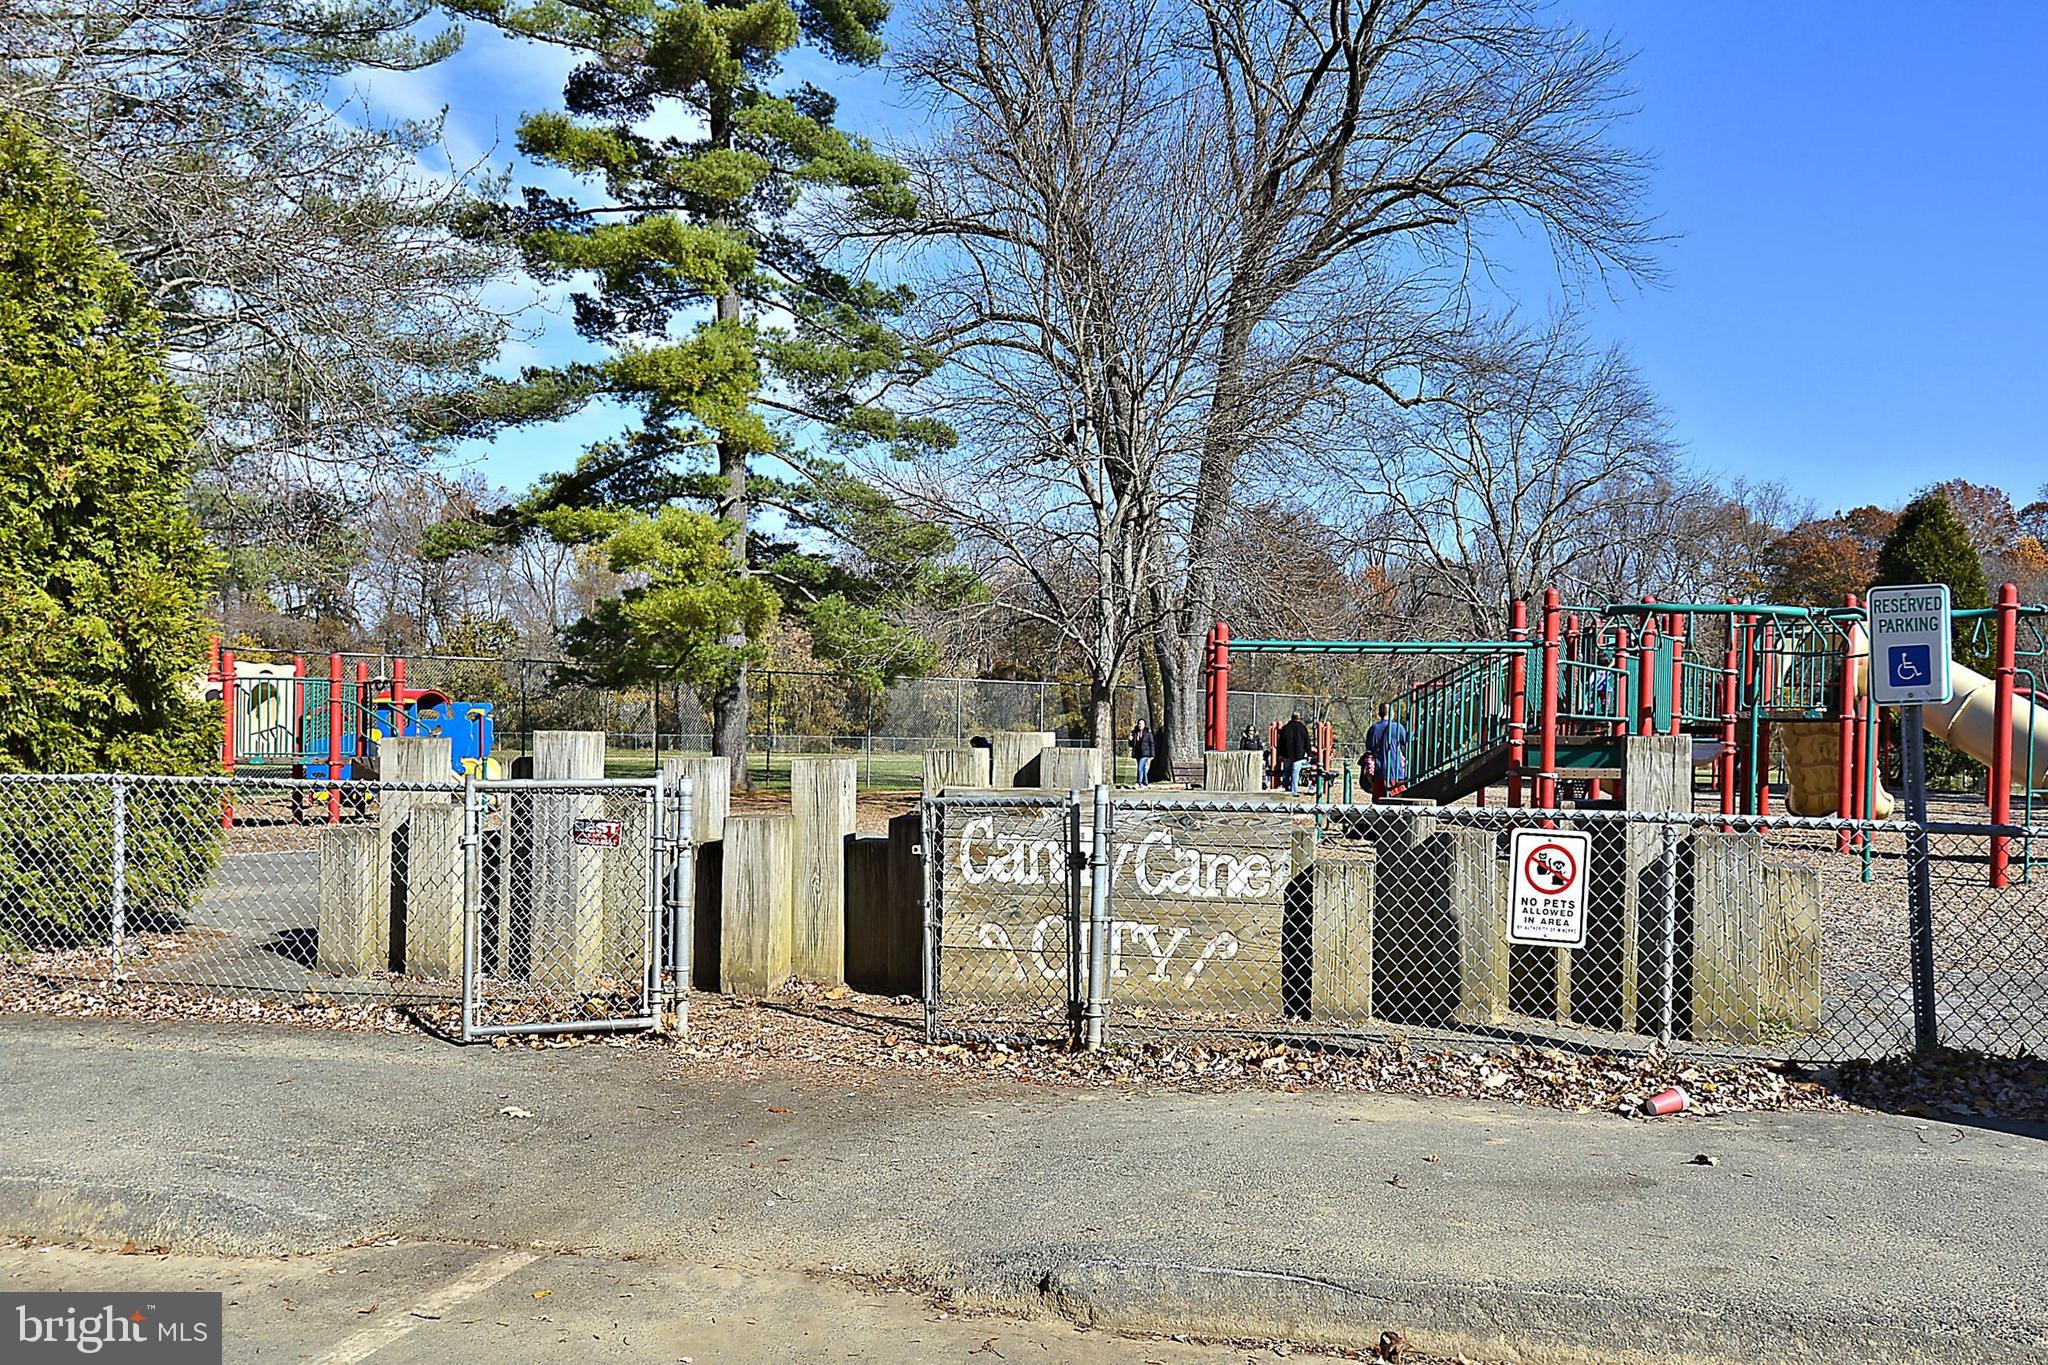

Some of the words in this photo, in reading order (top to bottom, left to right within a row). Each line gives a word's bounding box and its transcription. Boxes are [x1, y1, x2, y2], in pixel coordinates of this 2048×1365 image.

[1873, 596, 1942, 614] RESERVED
[1879, 616, 1939, 633] PARKING
[1521, 897, 1537, 906] NO
[1543, 899, 1575, 909] PETS
[1522, 907, 1574, 917] ALLOWED
[1540, 918, 1570, 926] AREA
